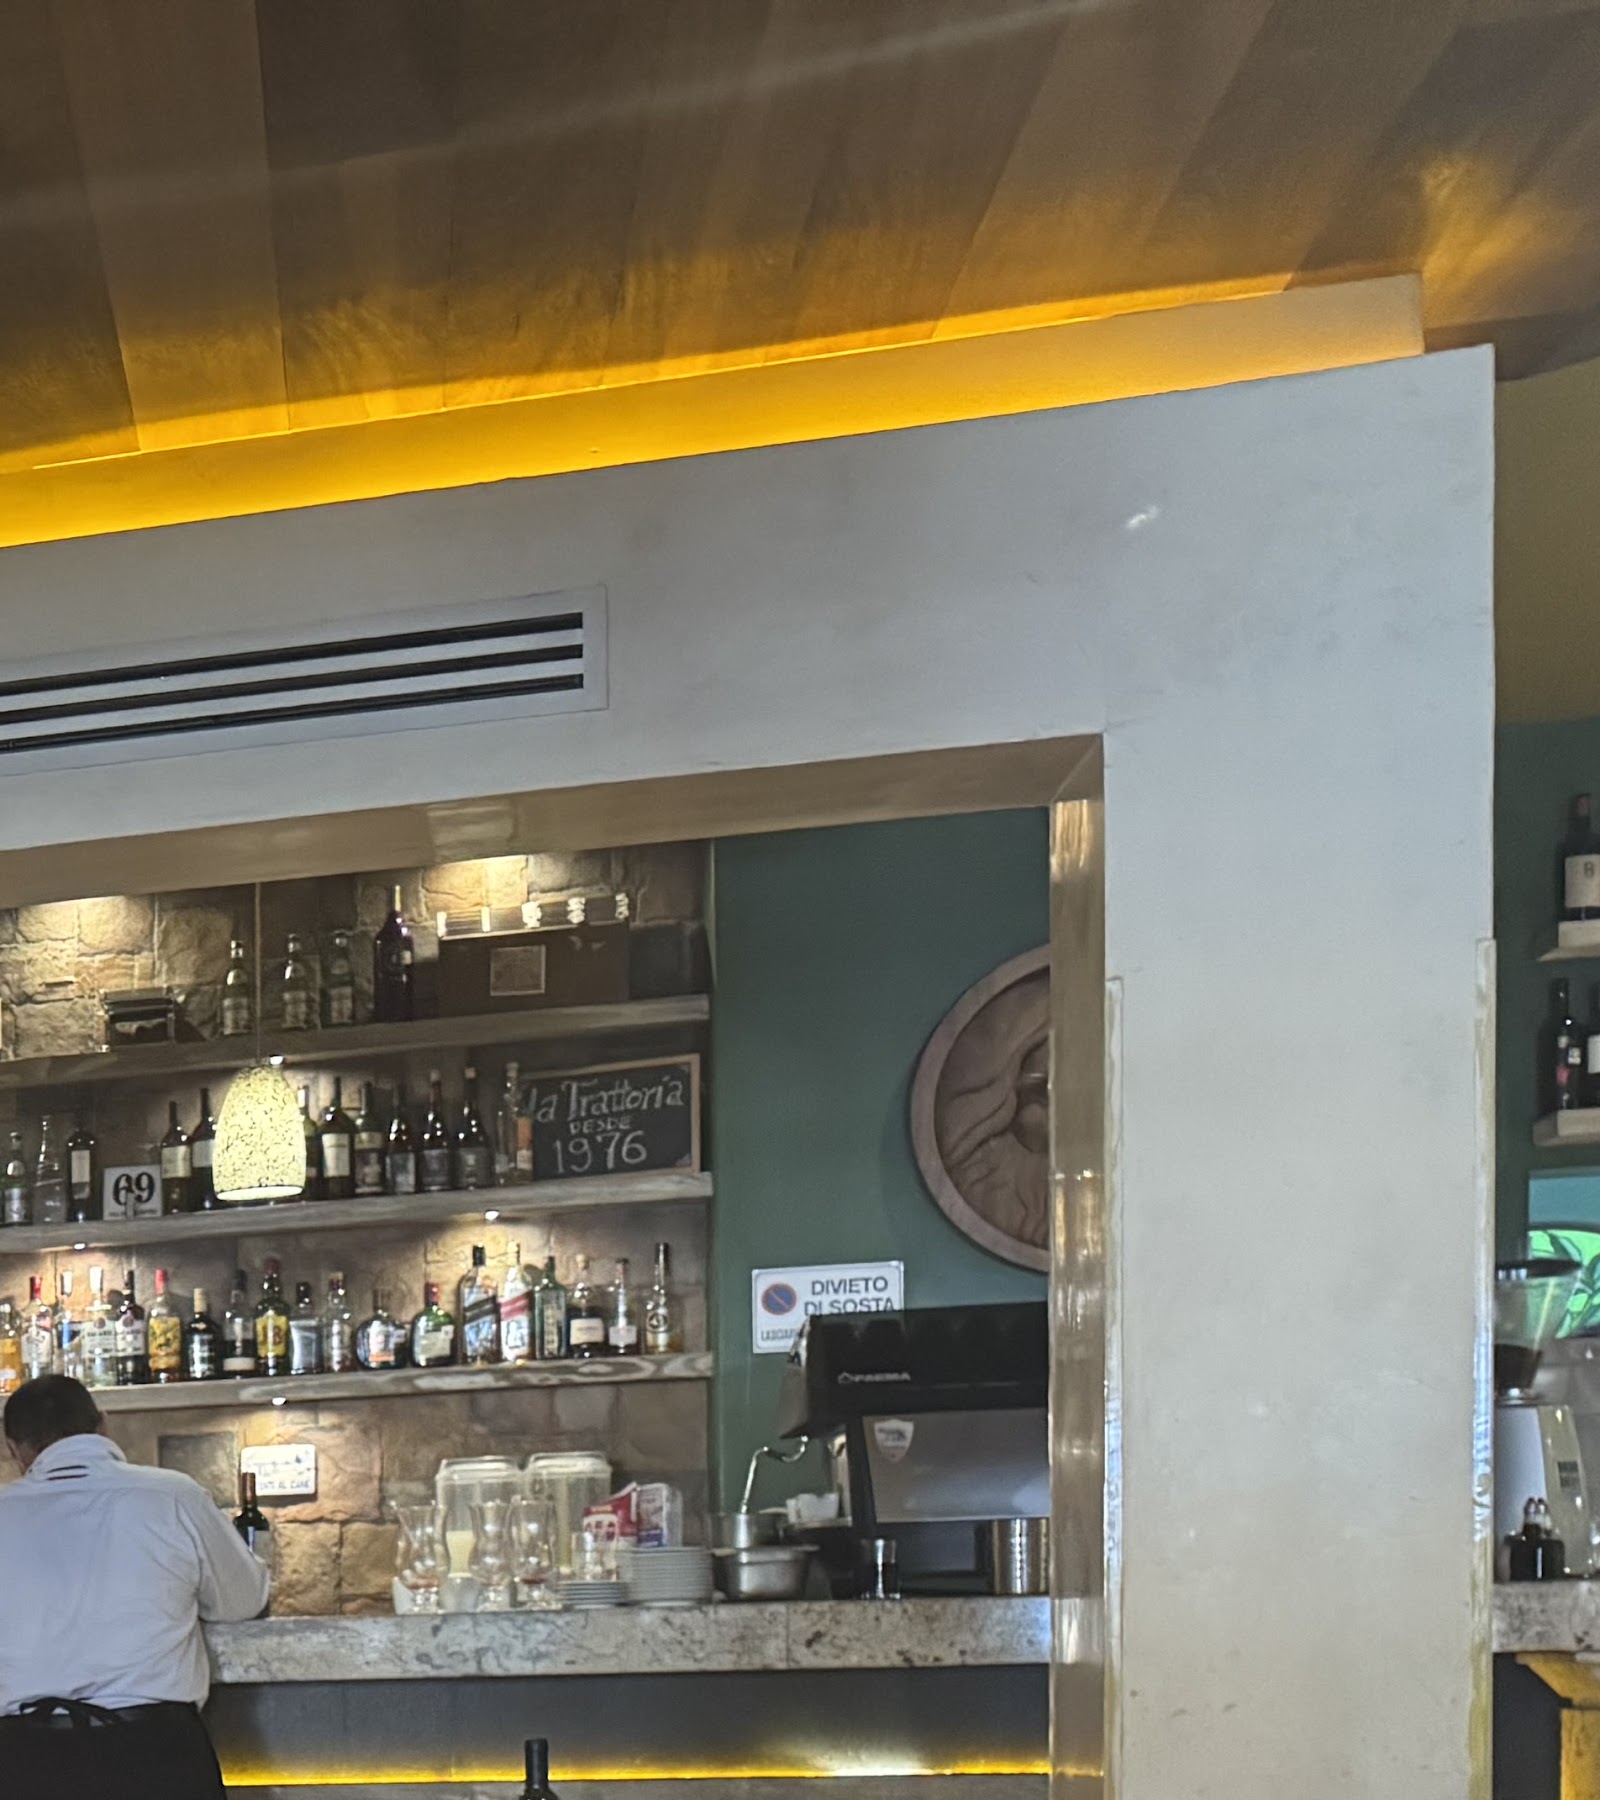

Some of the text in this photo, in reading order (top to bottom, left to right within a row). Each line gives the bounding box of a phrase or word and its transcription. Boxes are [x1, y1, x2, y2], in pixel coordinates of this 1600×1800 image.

[561, 1075, 685, 1122] Trattoria
[569, 1115, 633, 1134] DESDE
[113, 1172, 155, 1207] 69
[811, 1276, 889, 1296] DIVIETO
[804, 1297, 896, 1316] DI SOSTA
